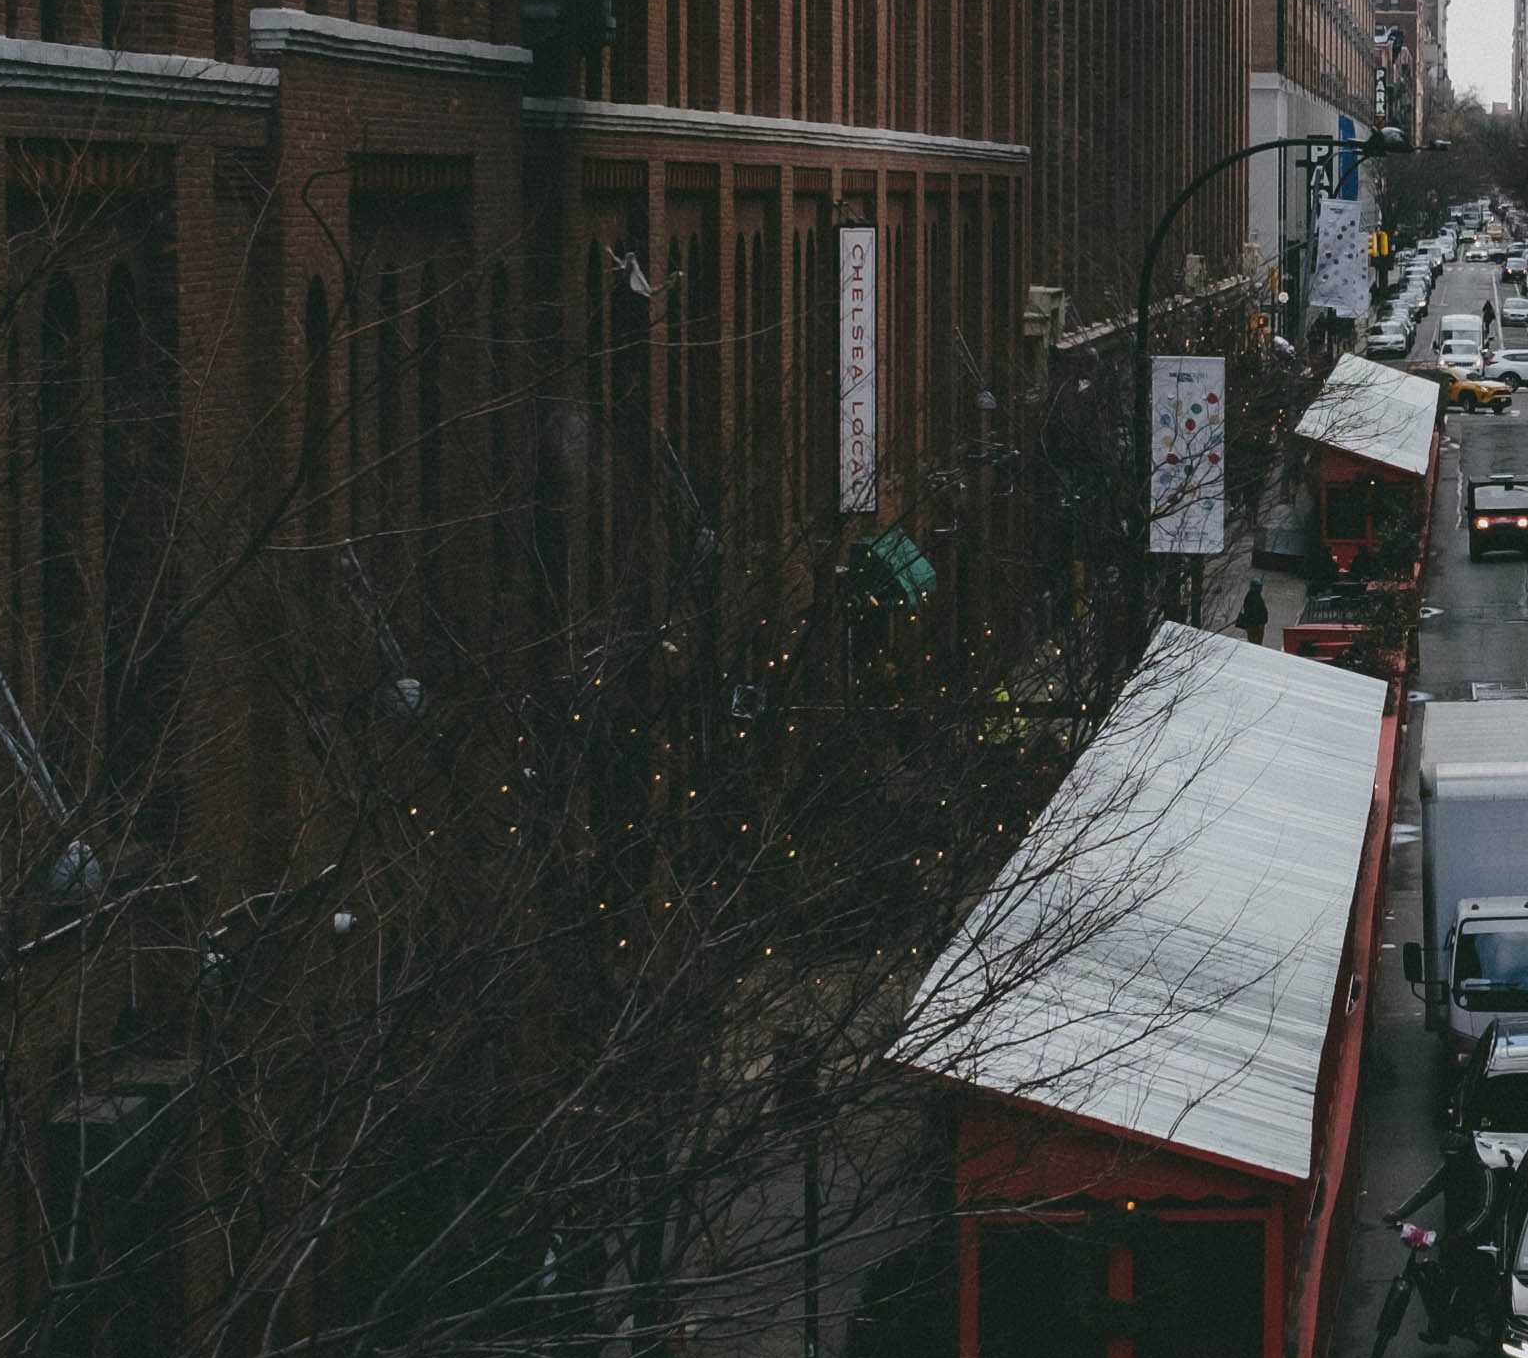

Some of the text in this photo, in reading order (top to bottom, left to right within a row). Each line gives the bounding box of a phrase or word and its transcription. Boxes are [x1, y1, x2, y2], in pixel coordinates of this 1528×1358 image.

[1376, 69, 1385, 115] PARK
[851, 244, 864, 494] CHELSEA LOCAL
